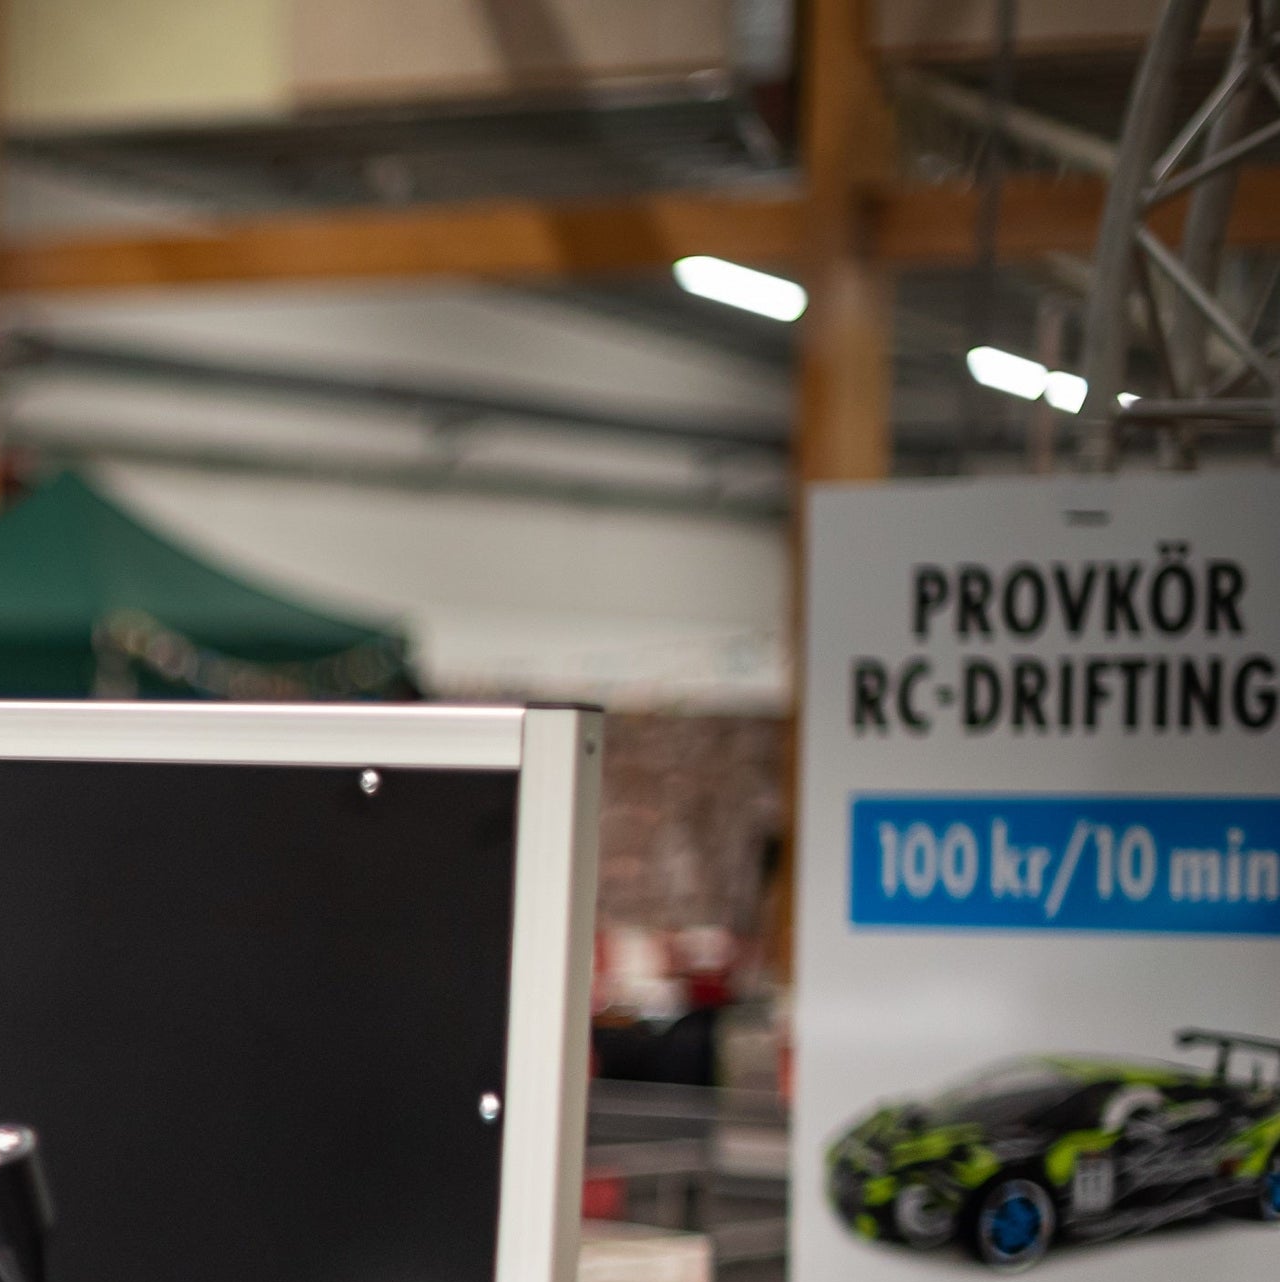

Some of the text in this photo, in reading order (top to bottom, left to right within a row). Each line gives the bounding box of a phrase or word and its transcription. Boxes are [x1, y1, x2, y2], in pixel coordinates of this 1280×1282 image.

[913, 541, 1246, 641] PROVKÖR
[878, 816, 1280, 919] 100 kr/10 min
